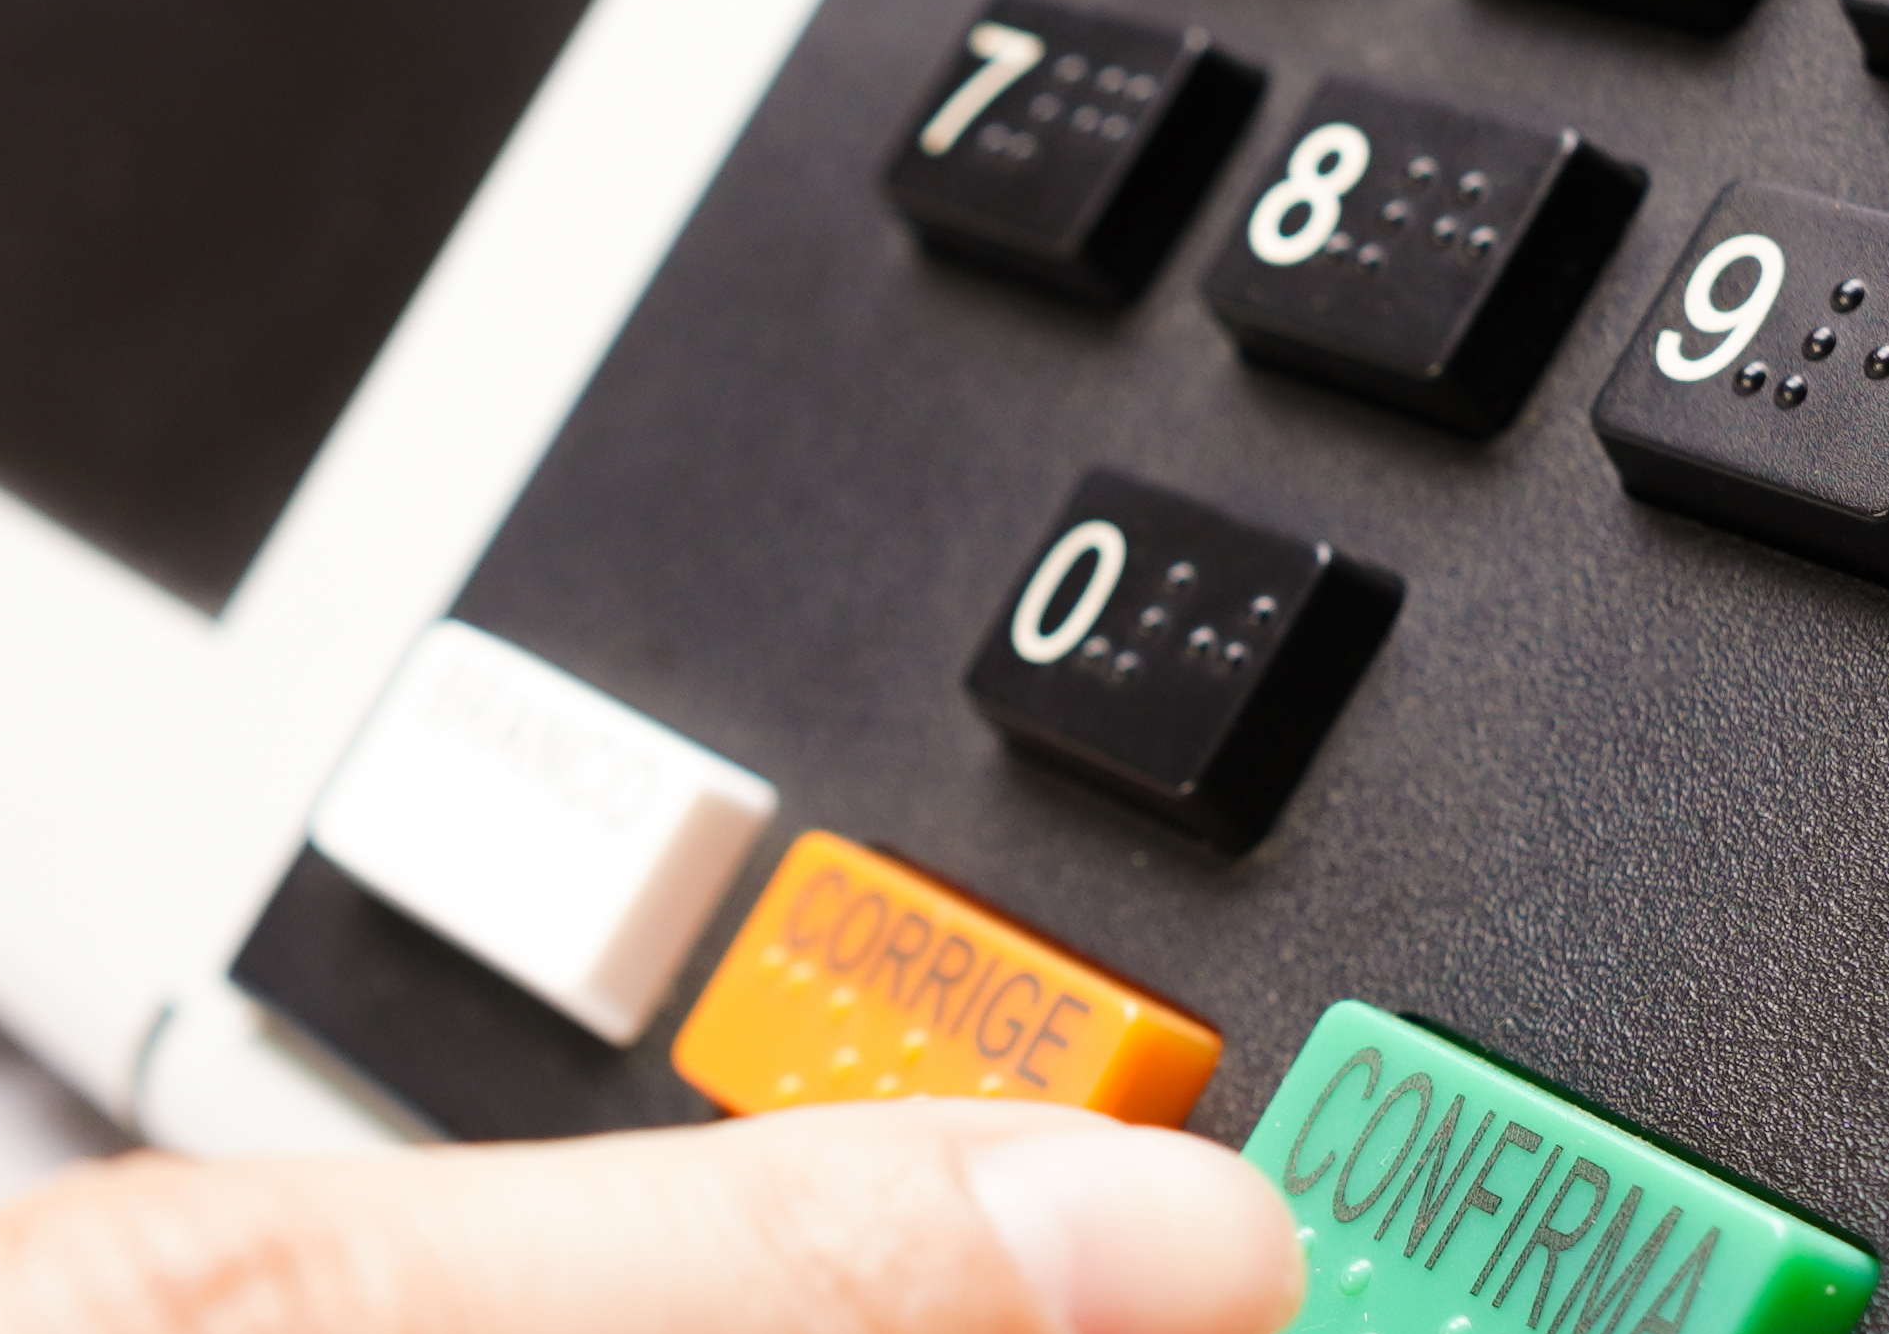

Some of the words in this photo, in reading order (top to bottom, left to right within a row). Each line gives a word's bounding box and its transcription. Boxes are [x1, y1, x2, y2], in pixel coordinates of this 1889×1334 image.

[918, 26, 1043, 155] 7
[1248, 125, 1370, 266] 8
[1655, 235, 1784, 381] 9
[1010, 522, 1123, 663] 0
[779, 866, 1092, 1093] CORRIGE
